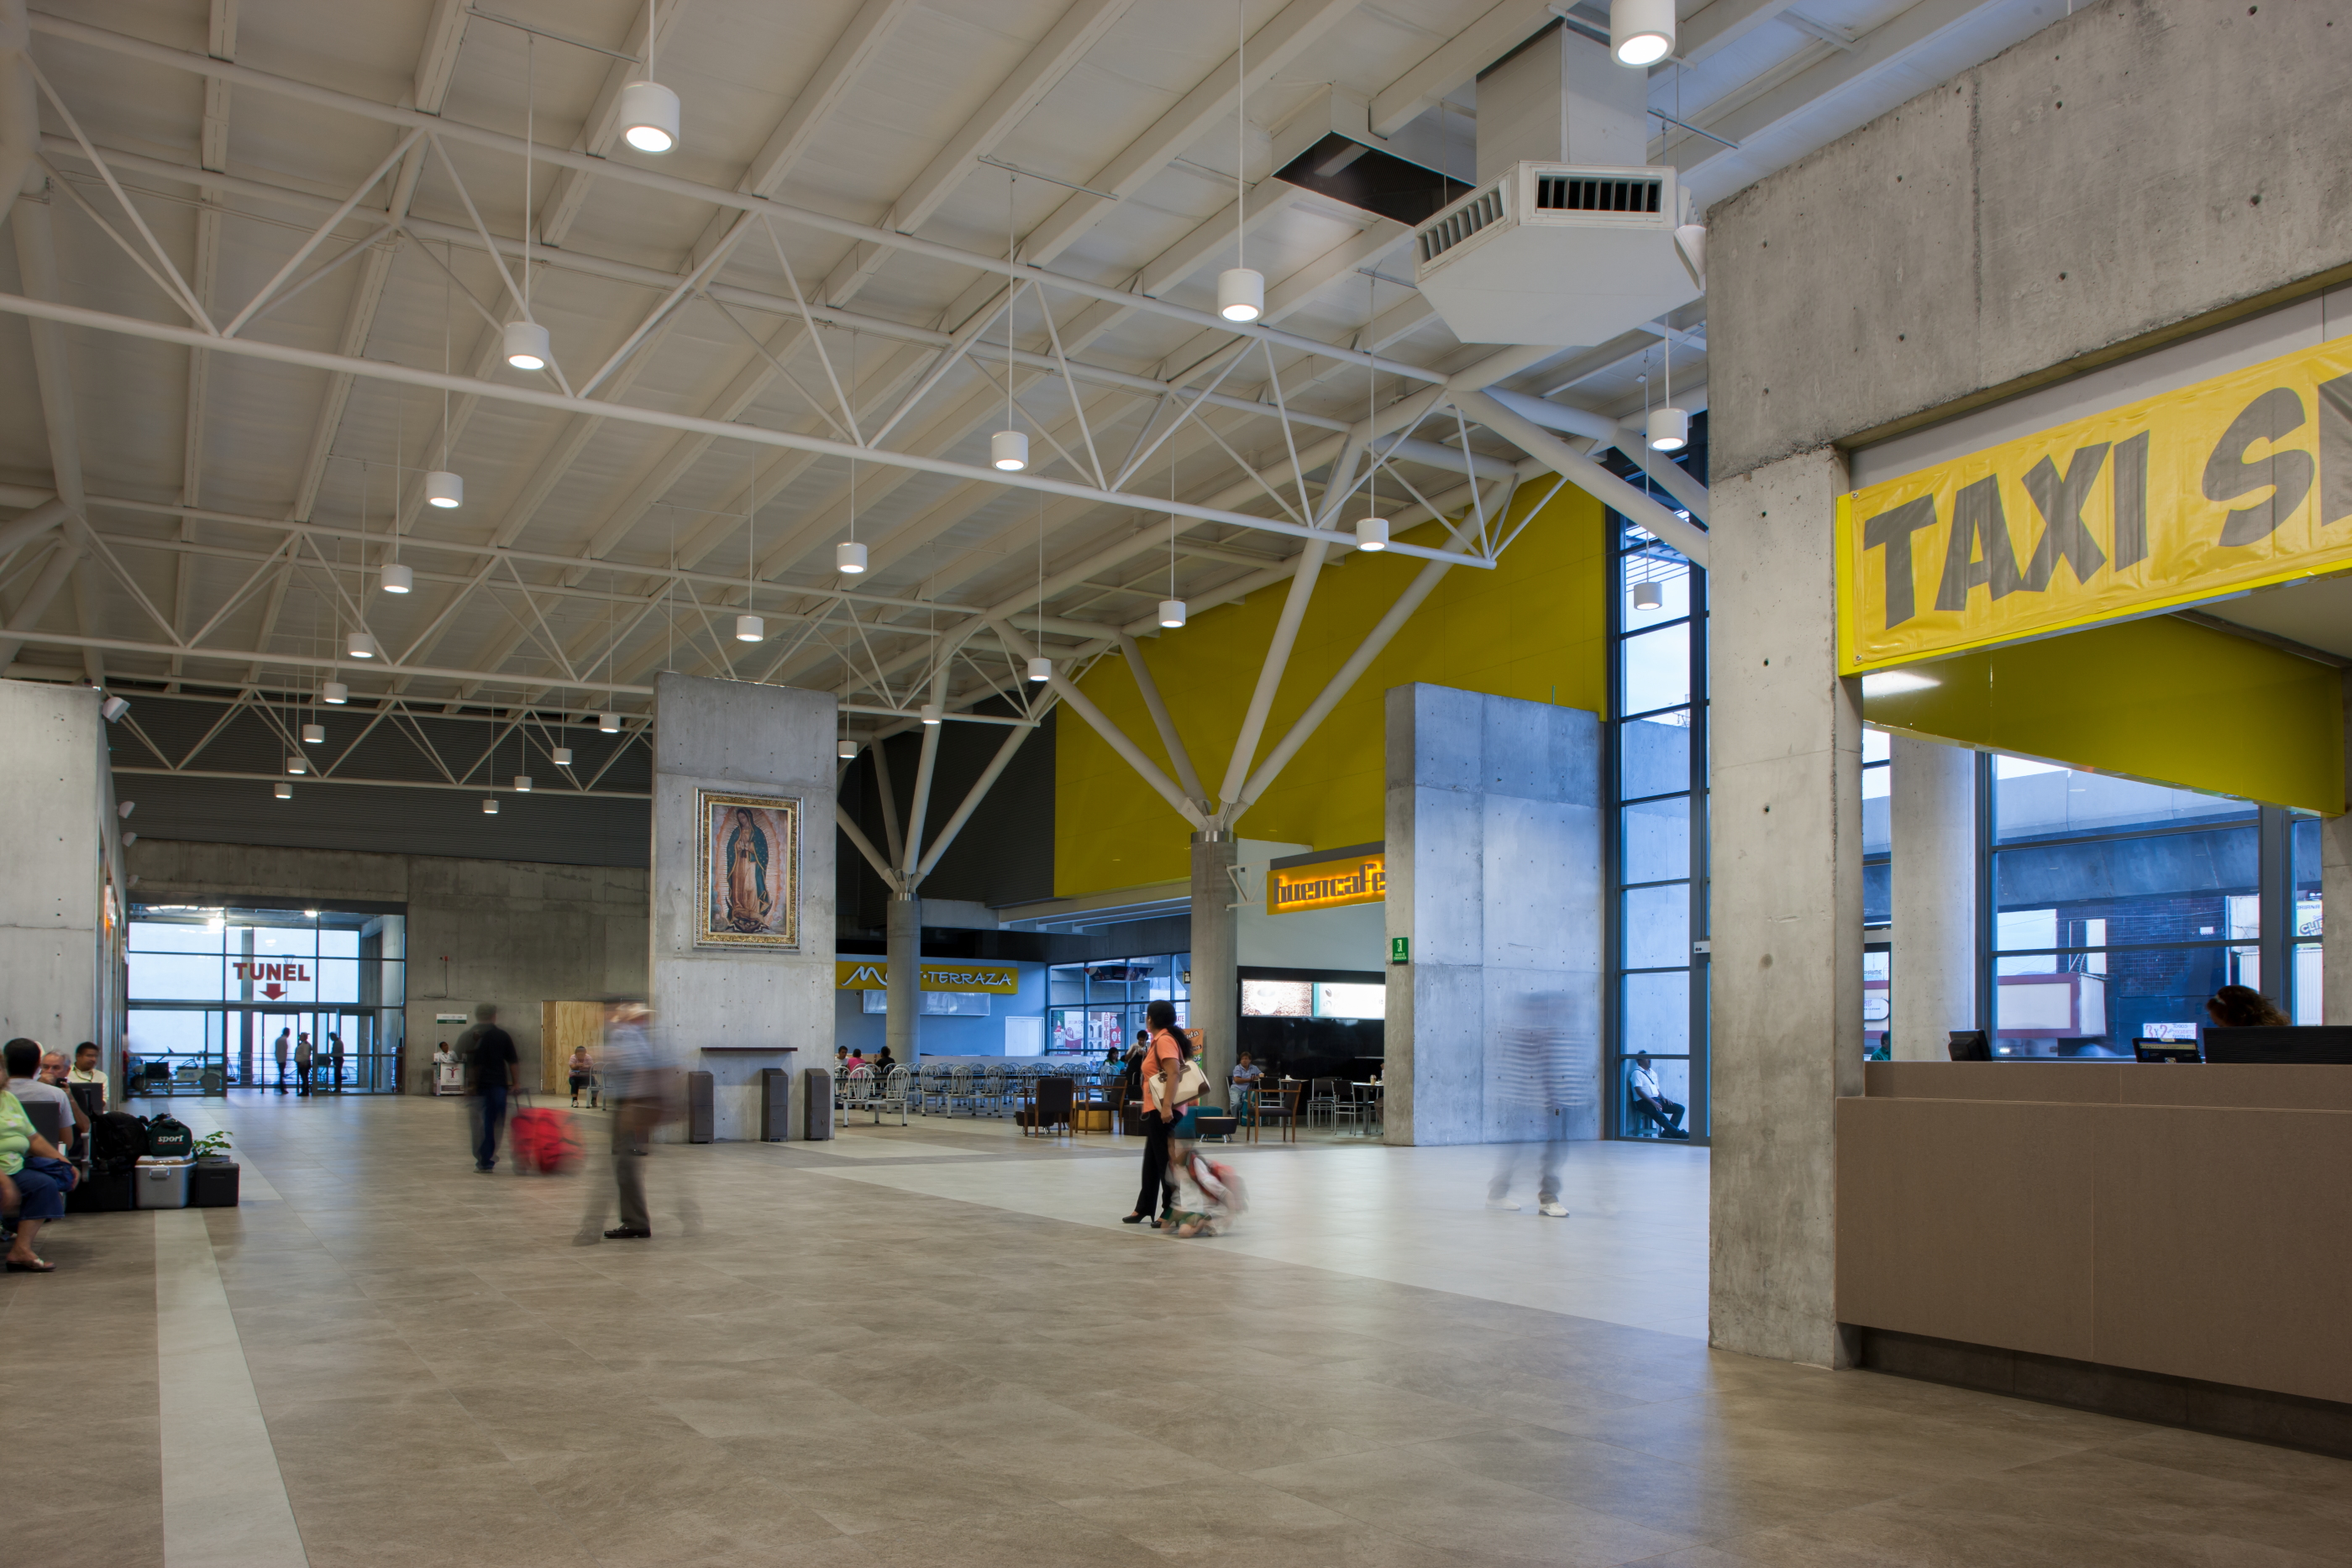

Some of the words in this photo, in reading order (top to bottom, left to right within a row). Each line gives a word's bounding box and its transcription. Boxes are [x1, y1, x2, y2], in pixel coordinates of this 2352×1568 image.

[1863, 429, 2150, 631] TAXI
[232, 962, 311, 982] TUNEL
[158, 1135, 184, 1143] sport
